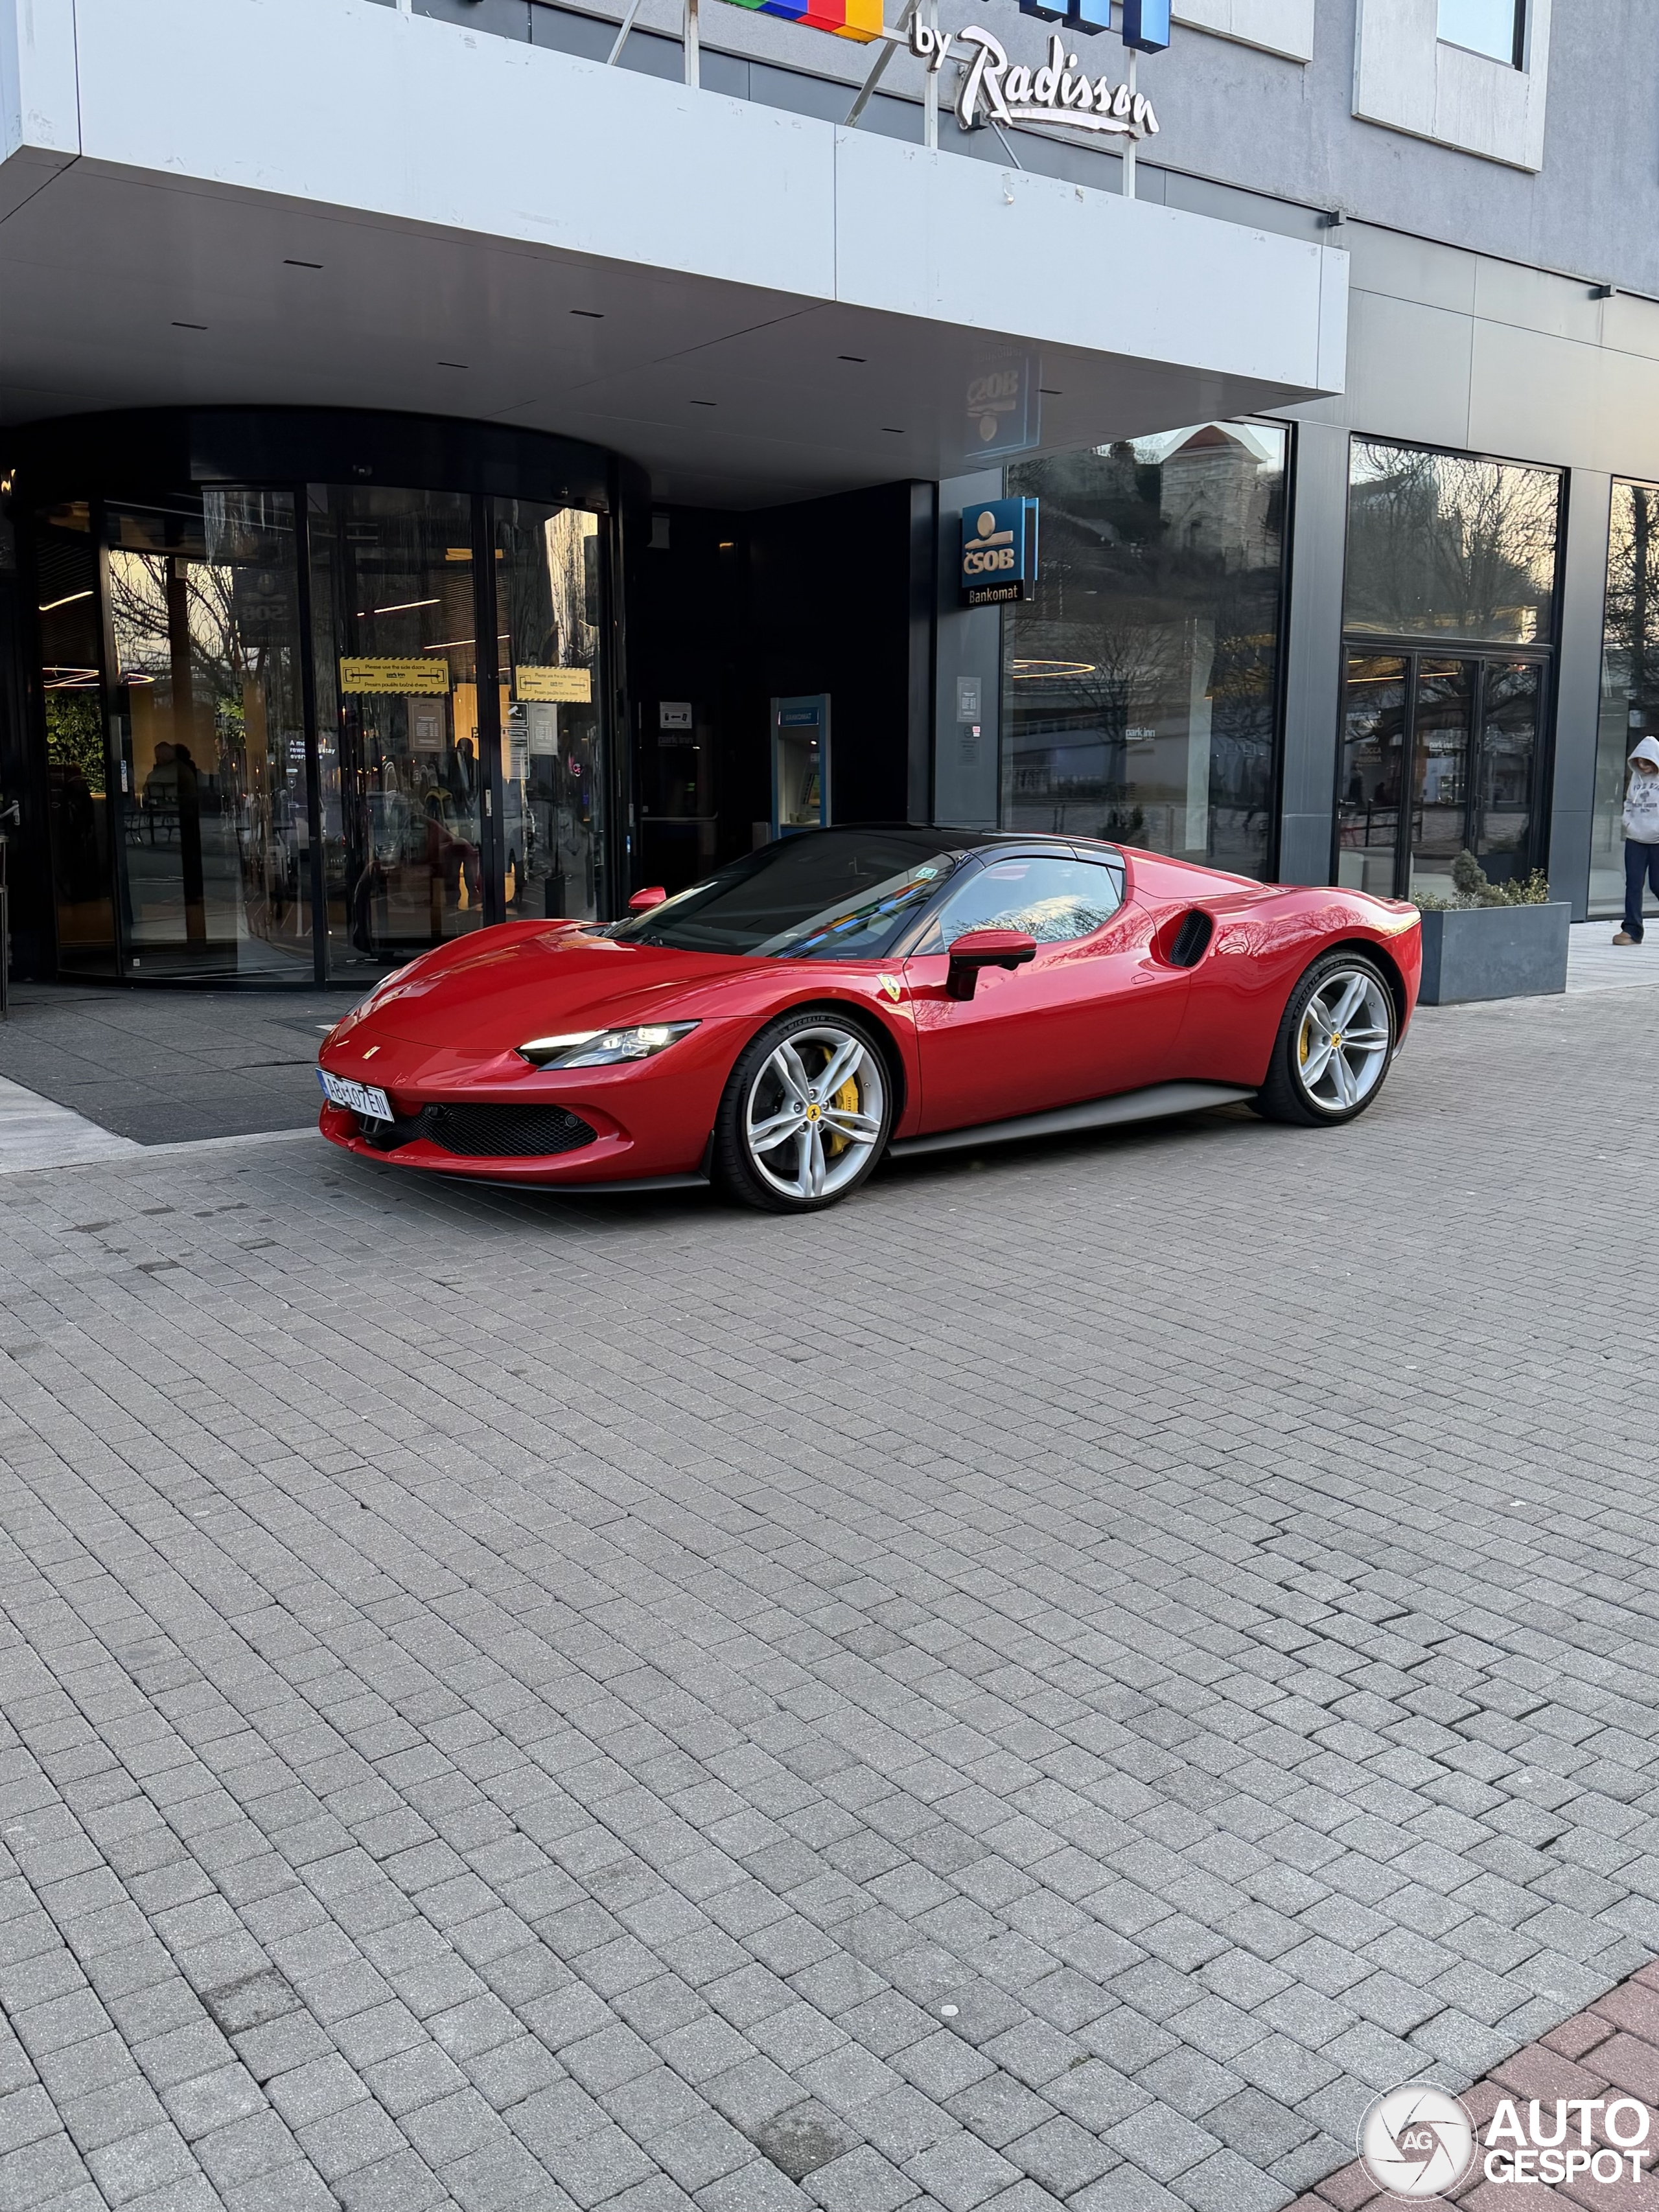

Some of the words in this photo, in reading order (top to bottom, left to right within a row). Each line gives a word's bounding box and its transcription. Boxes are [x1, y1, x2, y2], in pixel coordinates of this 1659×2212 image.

[910, 10, 952, 73] by
[957, 25, 1160, 137] Radisson
[964, 548, 1015, 575] ČSOB
[969, 585, 1018, 604] Bankomat
[1126, 727, 1143, 740] park
[787, 1016, 826, 1030] MICHELIN
